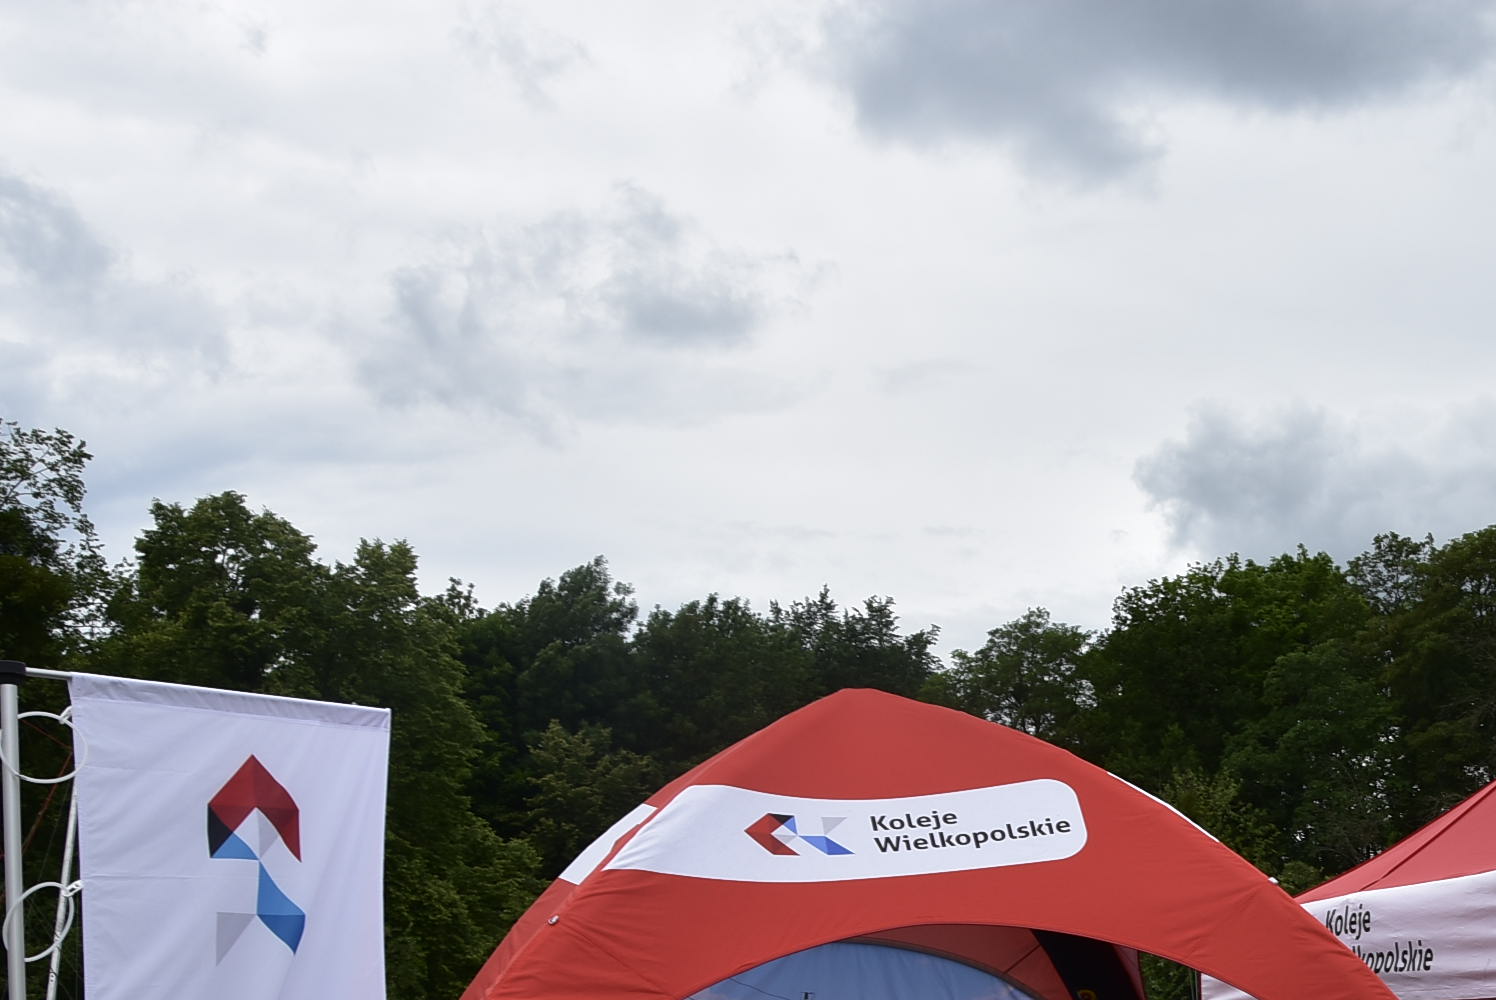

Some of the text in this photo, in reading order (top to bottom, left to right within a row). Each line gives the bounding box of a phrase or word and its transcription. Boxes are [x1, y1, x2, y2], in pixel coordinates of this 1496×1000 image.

[870, 810, 958, 831] Koleje
[874, 818, 1071, 853] Wielkopolskie
[1325, 903, 1371, 940] Koleje
[1352, 939, 1434, 974] opolskie
